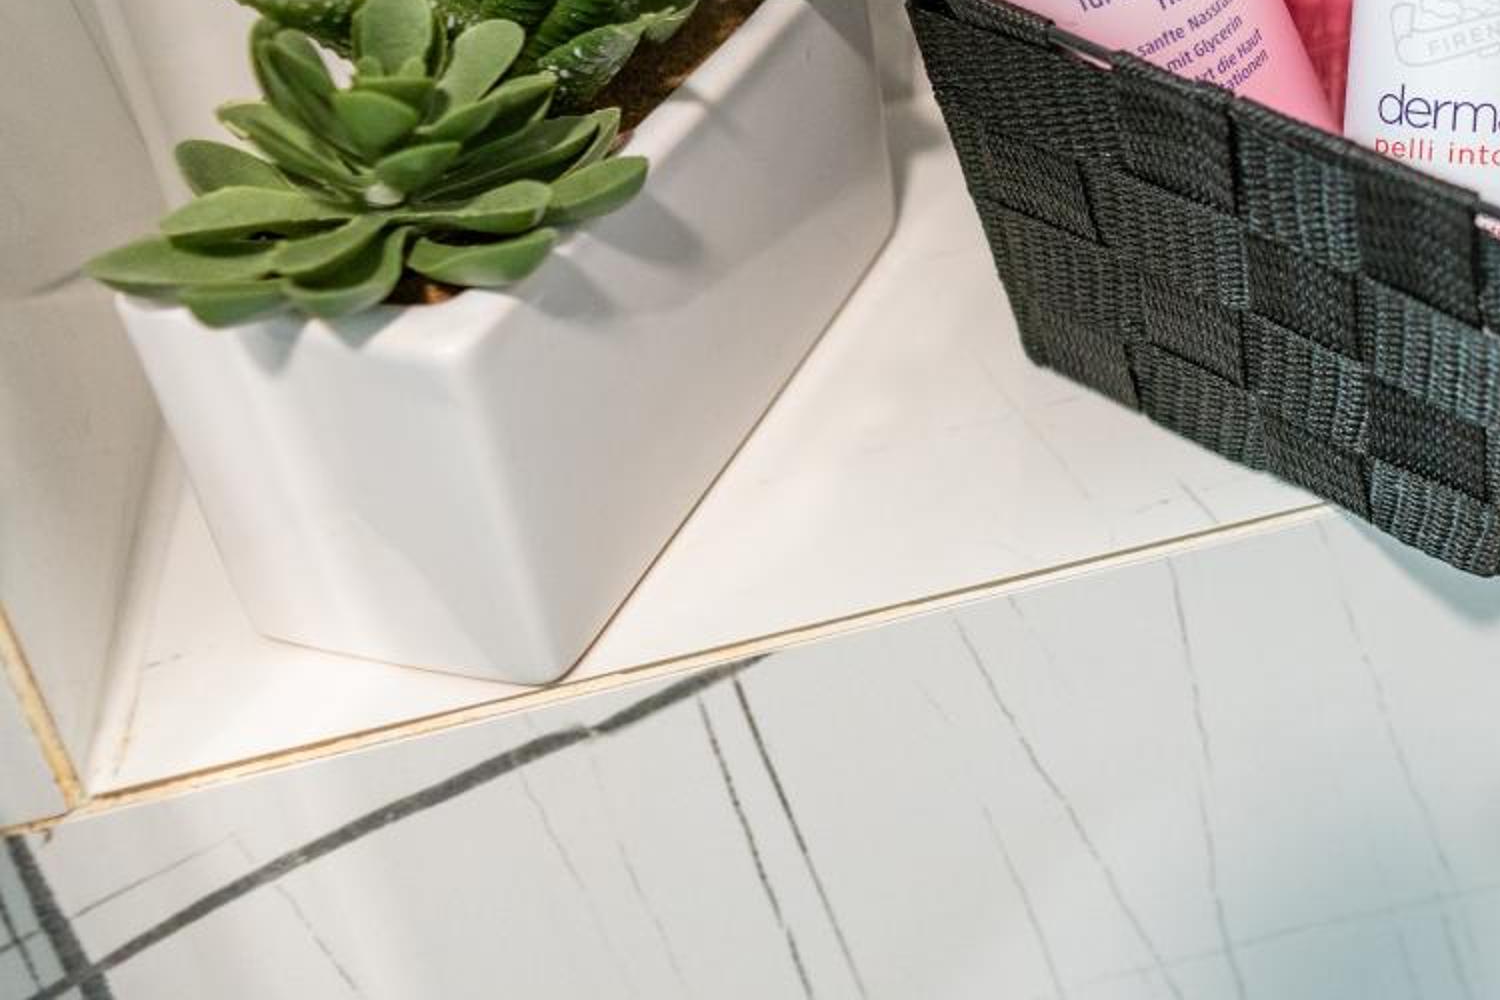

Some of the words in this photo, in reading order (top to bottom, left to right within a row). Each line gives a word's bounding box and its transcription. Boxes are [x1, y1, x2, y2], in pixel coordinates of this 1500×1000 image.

[1137, 27, 1185, 57] sanfte
[1166, 51, 1194, 72] mit
[1193, 15, 1243, 57] Glycerin
[1217, 54, 1237, 75] die
[1237, 28, 1263, 59] Haut
[1375, 137, 1433, 161] pelli
